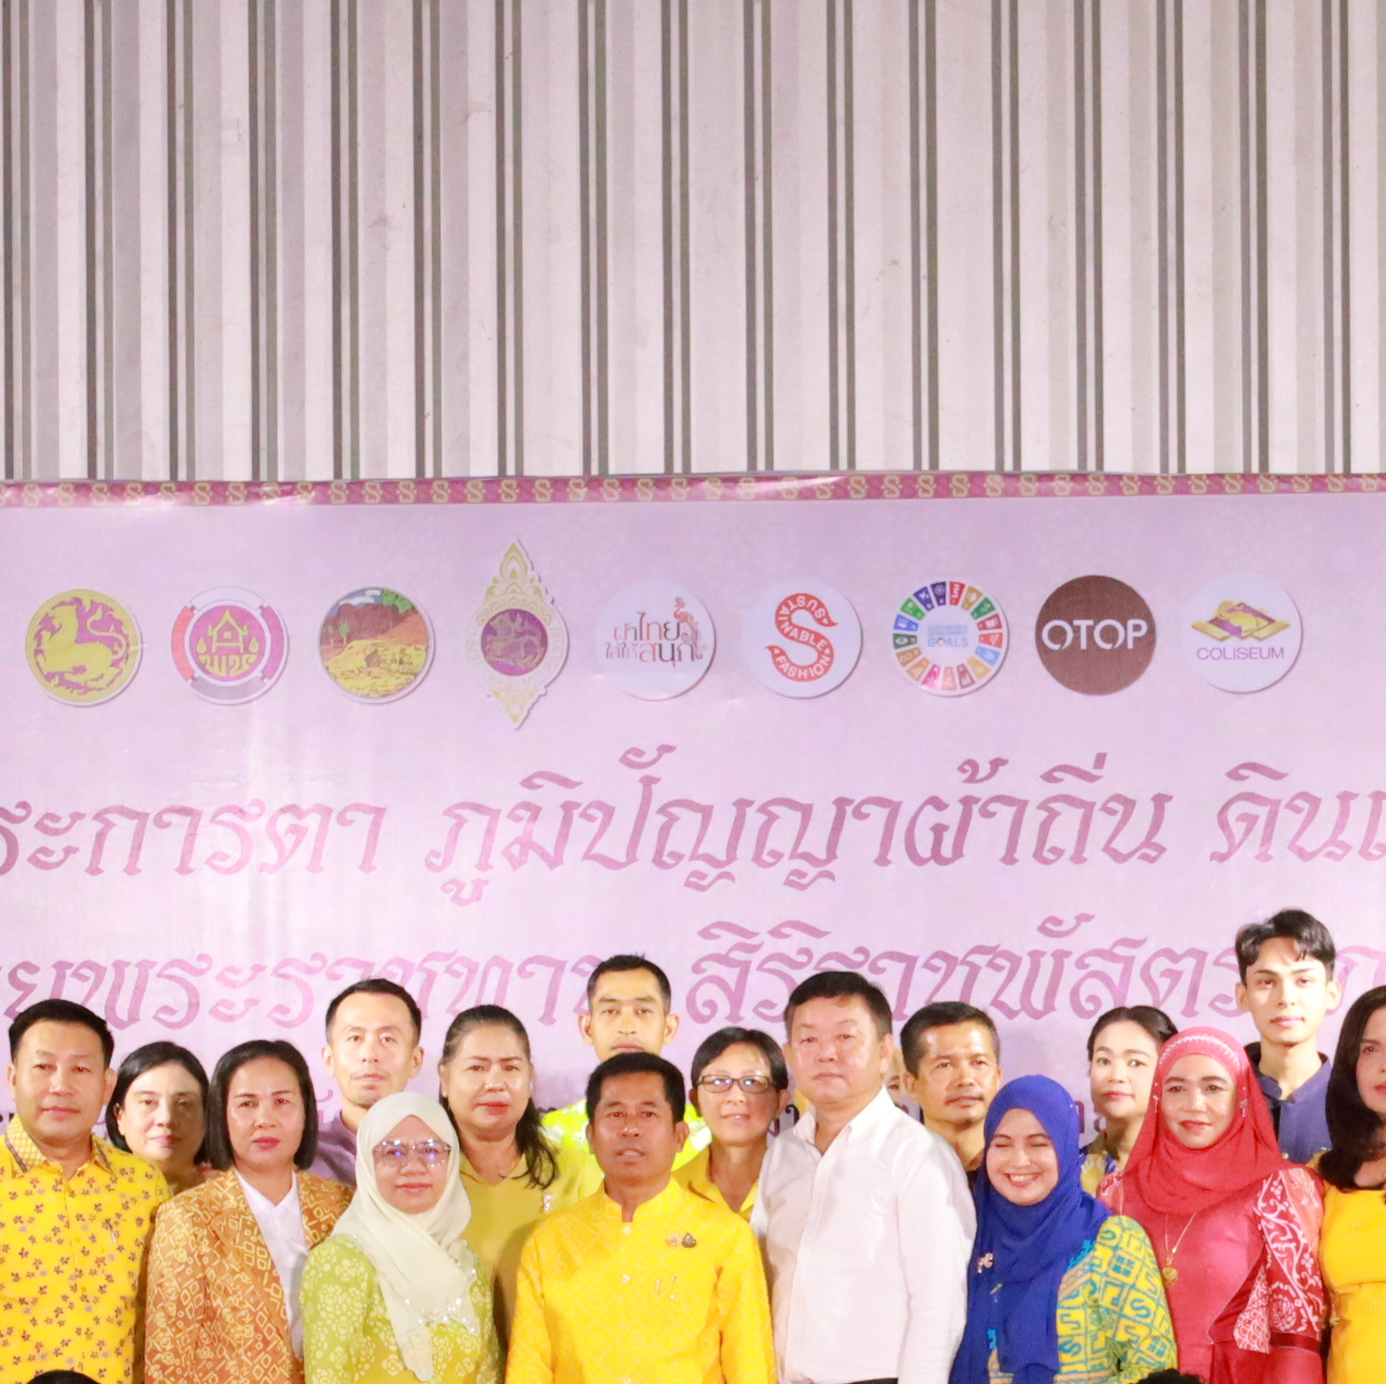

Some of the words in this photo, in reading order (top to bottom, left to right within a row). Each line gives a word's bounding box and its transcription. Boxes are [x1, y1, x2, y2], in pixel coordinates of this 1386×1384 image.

[1041, 618, 1148, 651] OTOP
[775, 653, 831, 679] FASHION
[1196, 646, 1285, 661] COLISEUM
[424, 743, 1173, 906] ภูมิปัญญาผ้าถิ่น
